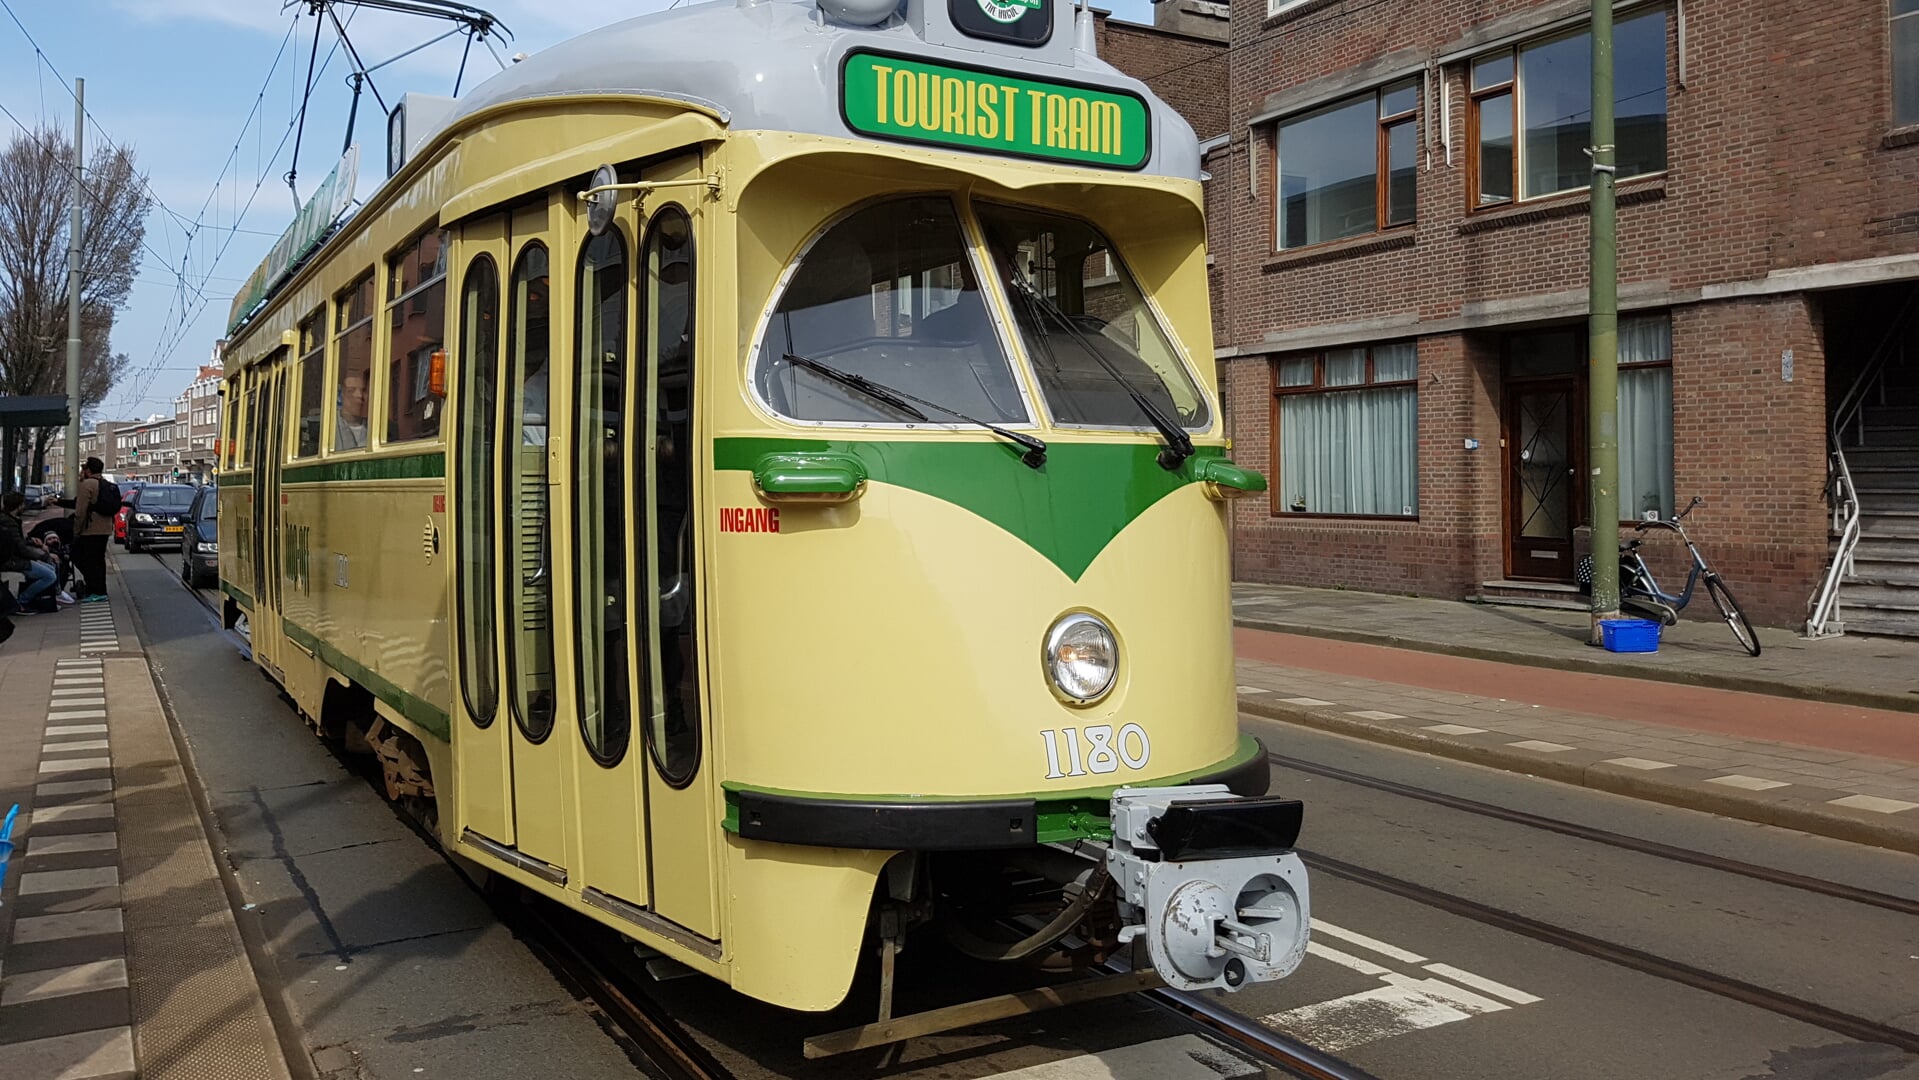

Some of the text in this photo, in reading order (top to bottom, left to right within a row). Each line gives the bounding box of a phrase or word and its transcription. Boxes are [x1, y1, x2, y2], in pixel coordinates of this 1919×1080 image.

[985, 2, 1019, 19] THE HAGUE
[871, 64, 1122, 156] TOURIST TRAM
[719, 507, 780, 533] INGANG
[1040, 722, 1151, 779] 1180
